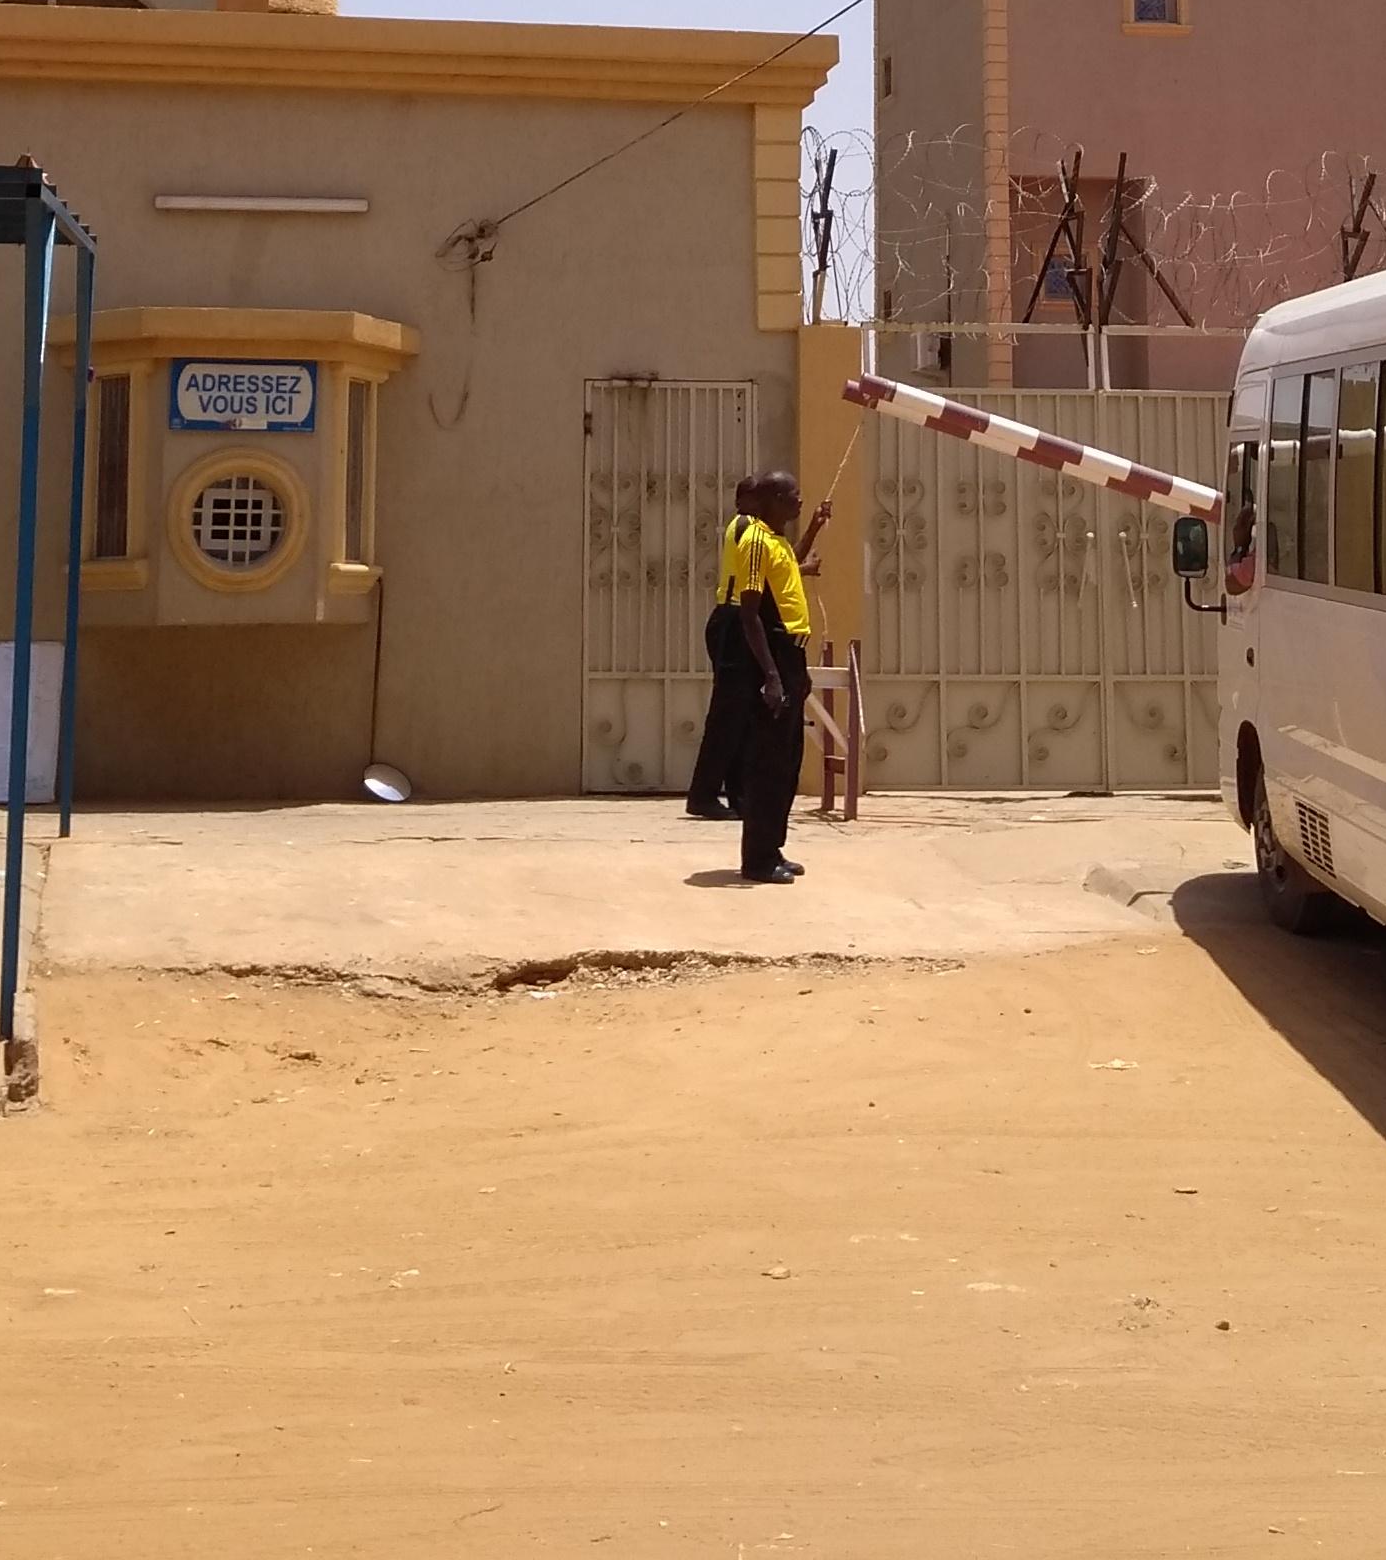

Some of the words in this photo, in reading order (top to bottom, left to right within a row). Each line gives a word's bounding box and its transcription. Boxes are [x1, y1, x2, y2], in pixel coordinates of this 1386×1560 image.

[185, 373, 303, 394] ADRESSEZ
[198, 395, 259, 415] VOUS
[264, 396, 294, 415] ICI
